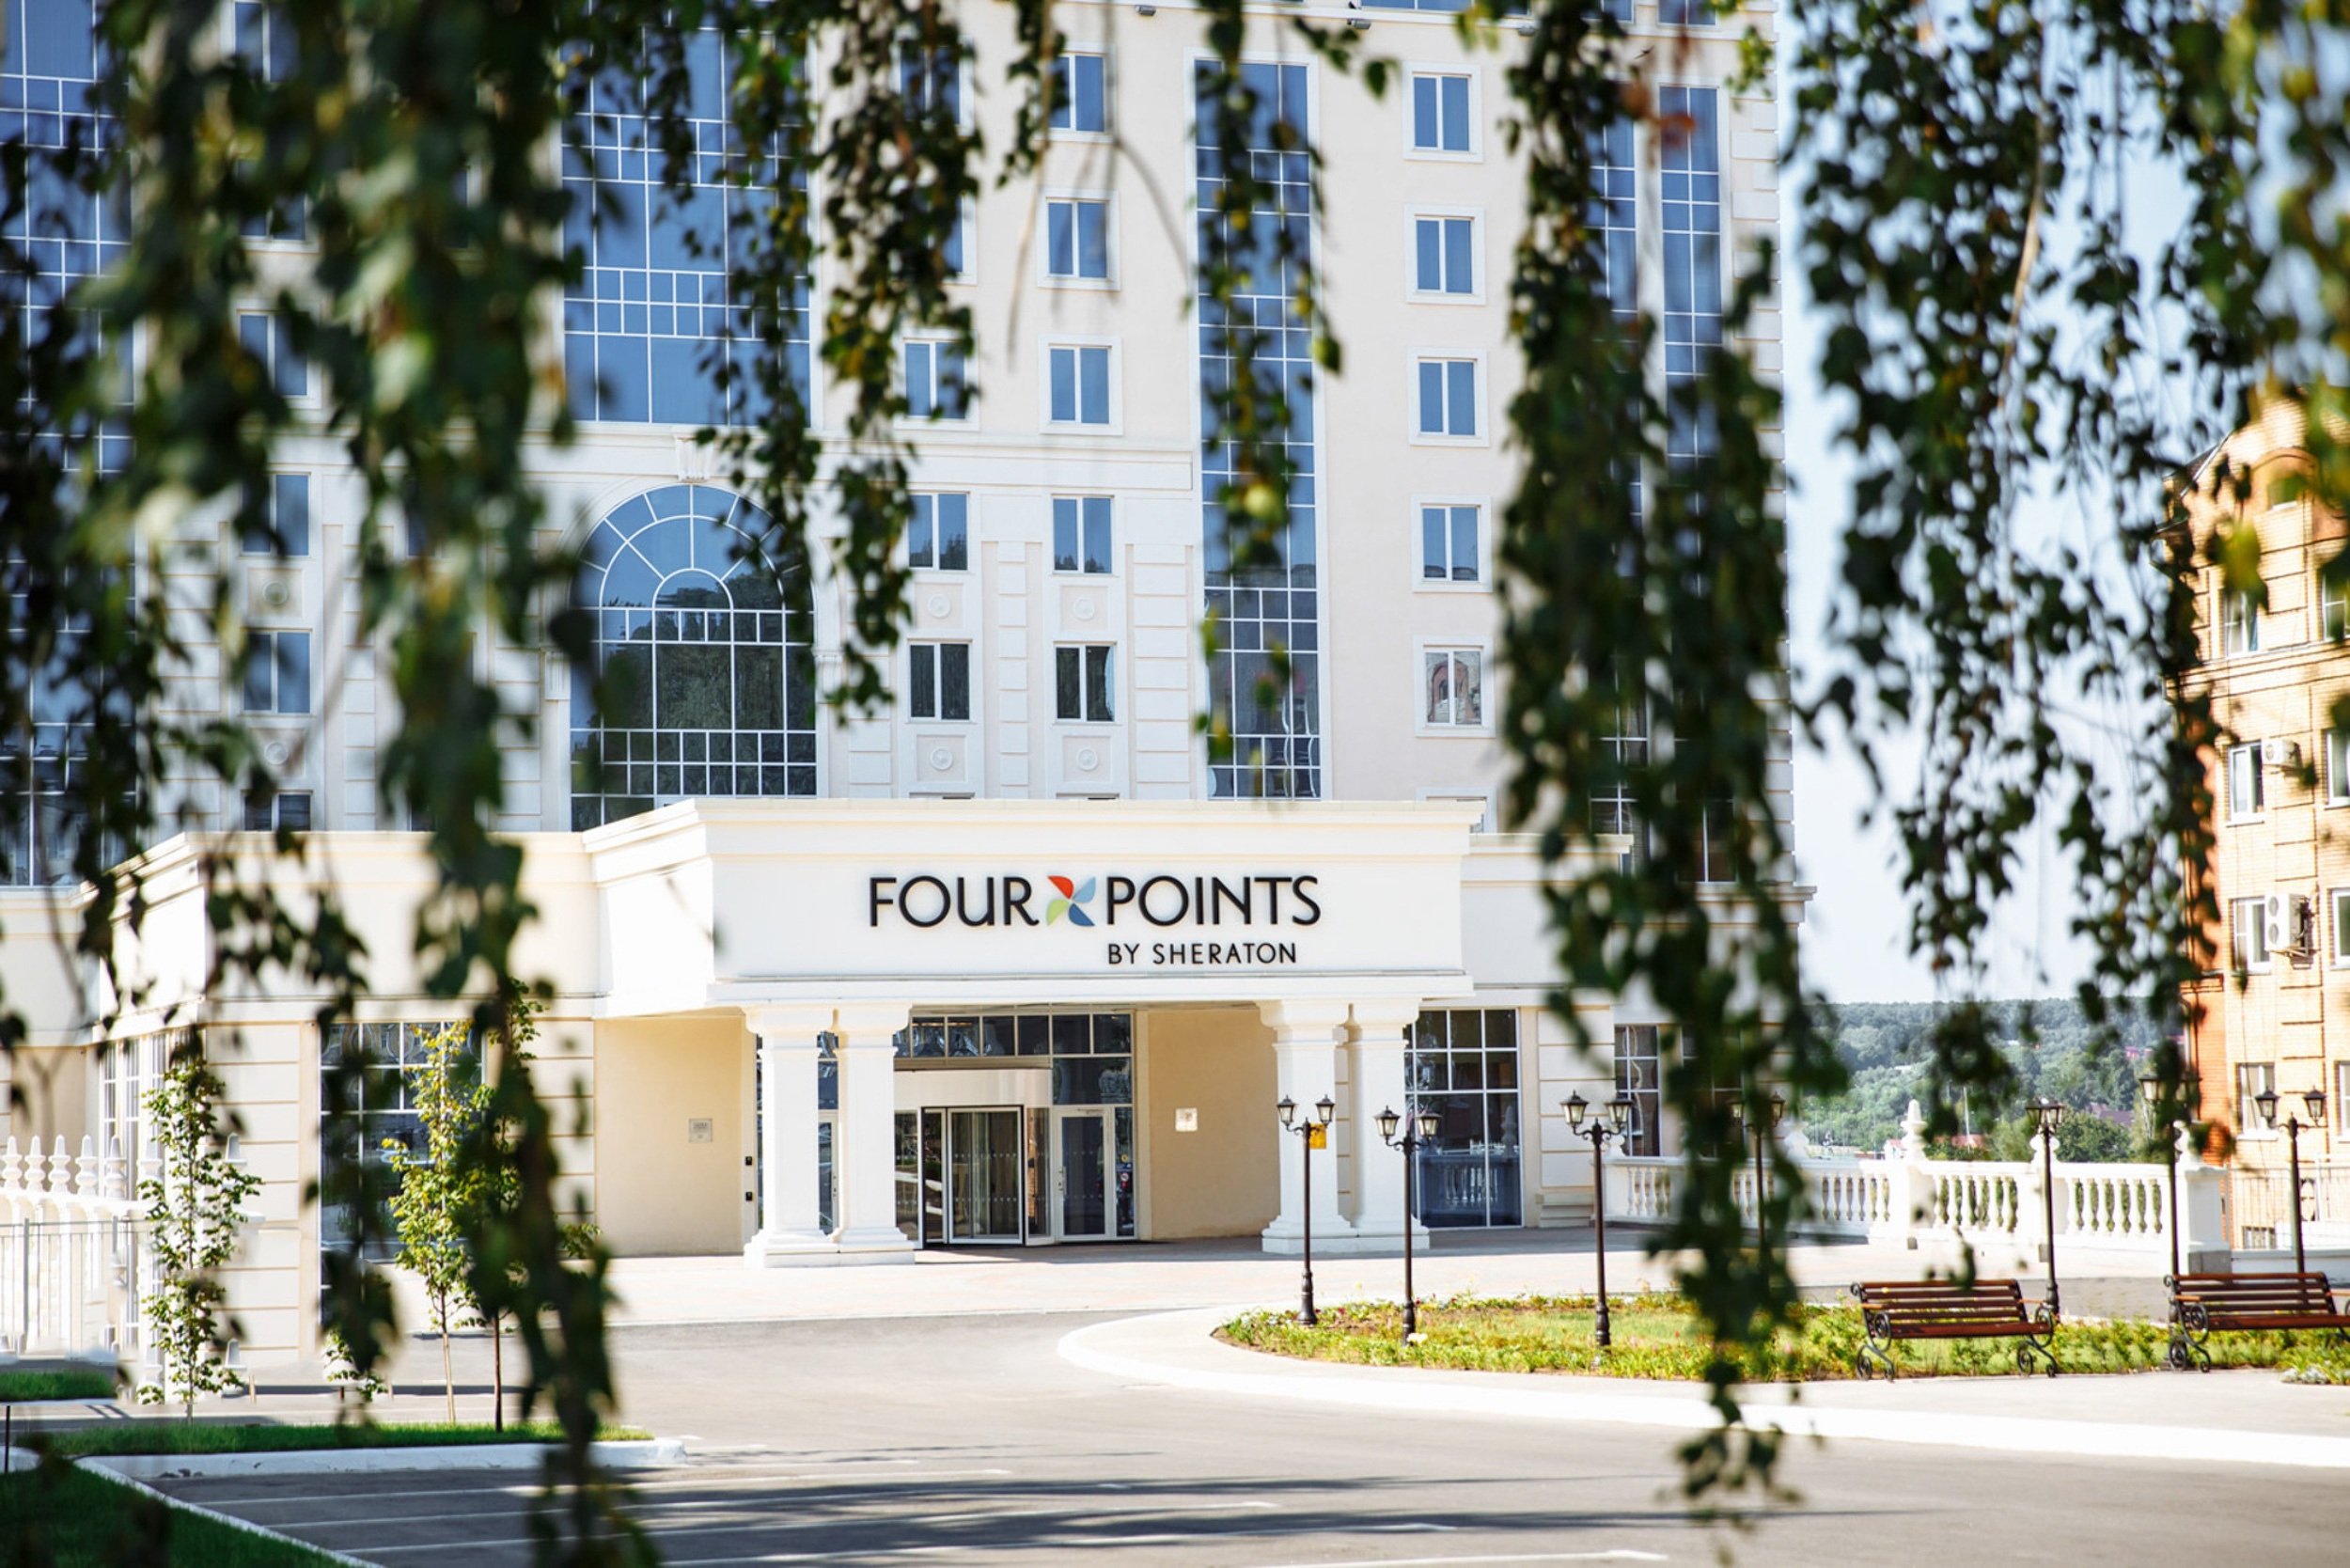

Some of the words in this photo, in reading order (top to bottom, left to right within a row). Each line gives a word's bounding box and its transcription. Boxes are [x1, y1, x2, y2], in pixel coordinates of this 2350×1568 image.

[870, 875, 1041, 928] FOUR
[1106, 875, 1322, 927] POINTS
[1108, 943, 1140, 964] BY
[1152, 942, 1296, 964] SHERATON
